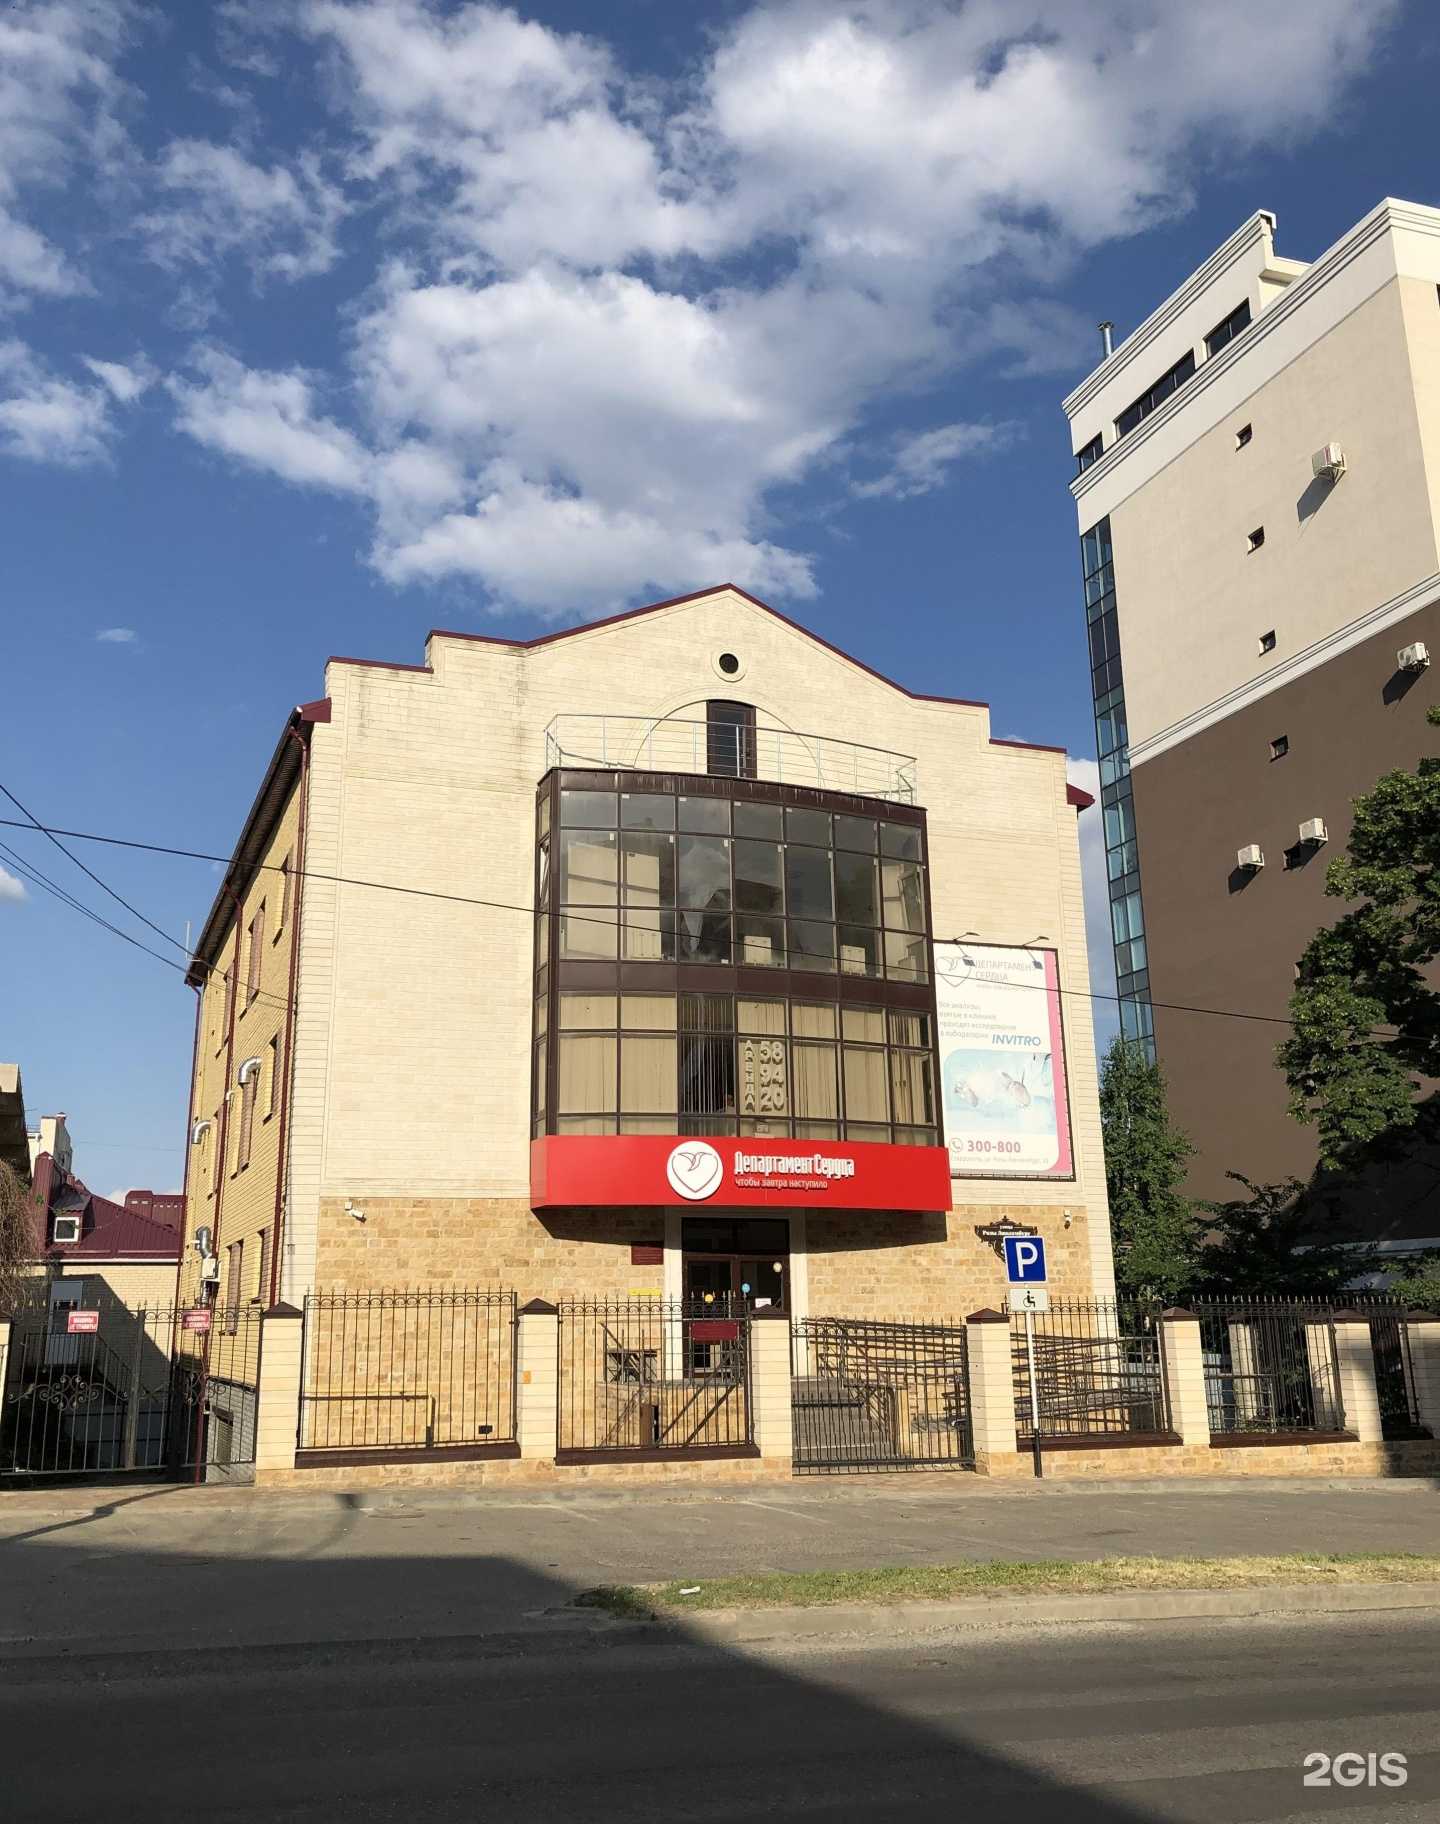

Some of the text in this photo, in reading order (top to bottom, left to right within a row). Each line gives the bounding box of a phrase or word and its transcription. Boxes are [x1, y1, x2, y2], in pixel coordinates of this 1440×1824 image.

[974, 959, 1038, 972] ДЕПАРТАМЕН
[992, 1034, 1041, 1046] INVITRO
[760, 1041, 783, 1063] 58
[761, 1087, 785, 1111] 20
[968, 1140, 1021, 1153] 300-800
[735, 1151, 855, 1178] Департамент Сердца
[736, 1178, 828, 1190] чтобы завтра наступило
